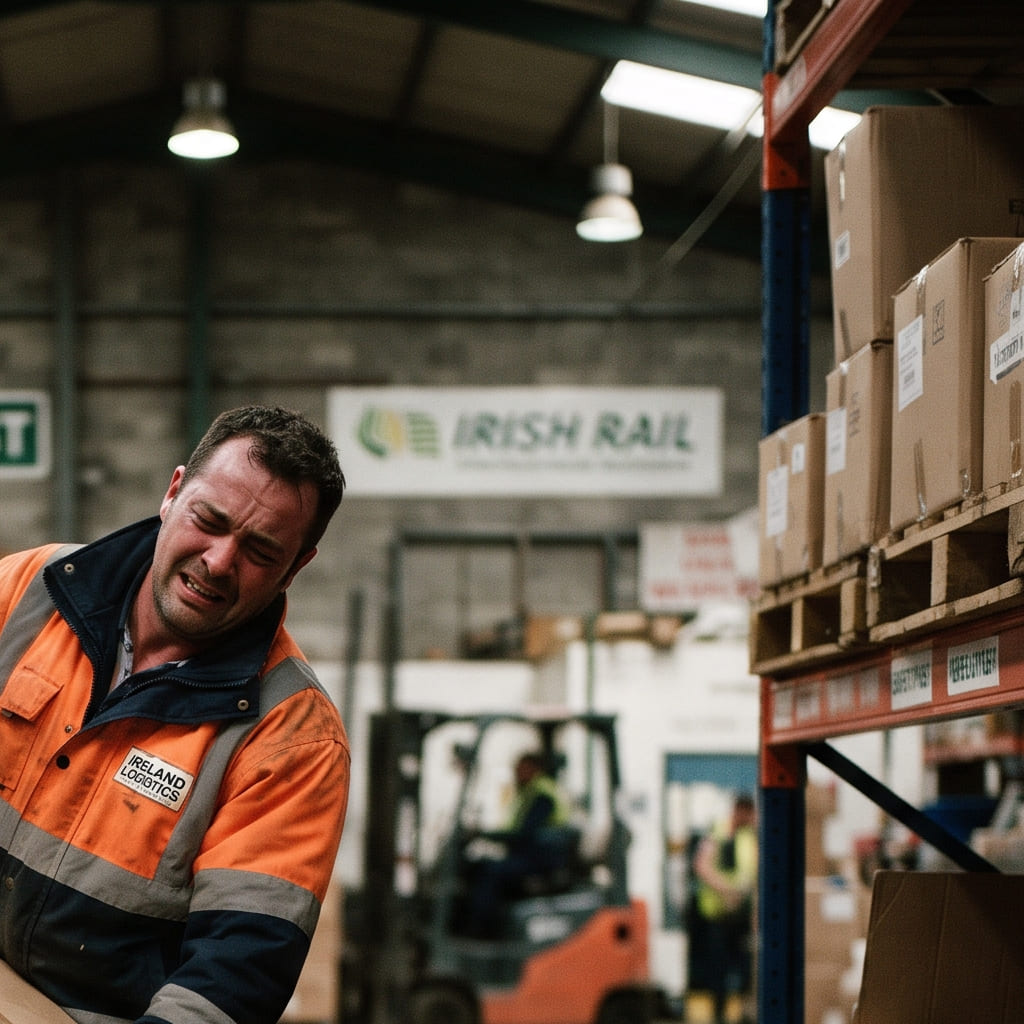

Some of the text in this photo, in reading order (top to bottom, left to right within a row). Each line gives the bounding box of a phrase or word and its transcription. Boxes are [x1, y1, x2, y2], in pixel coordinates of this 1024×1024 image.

[452, 410, 696, 452] IRISH RAIL
[128, 754, 186, 790] IRELAND
